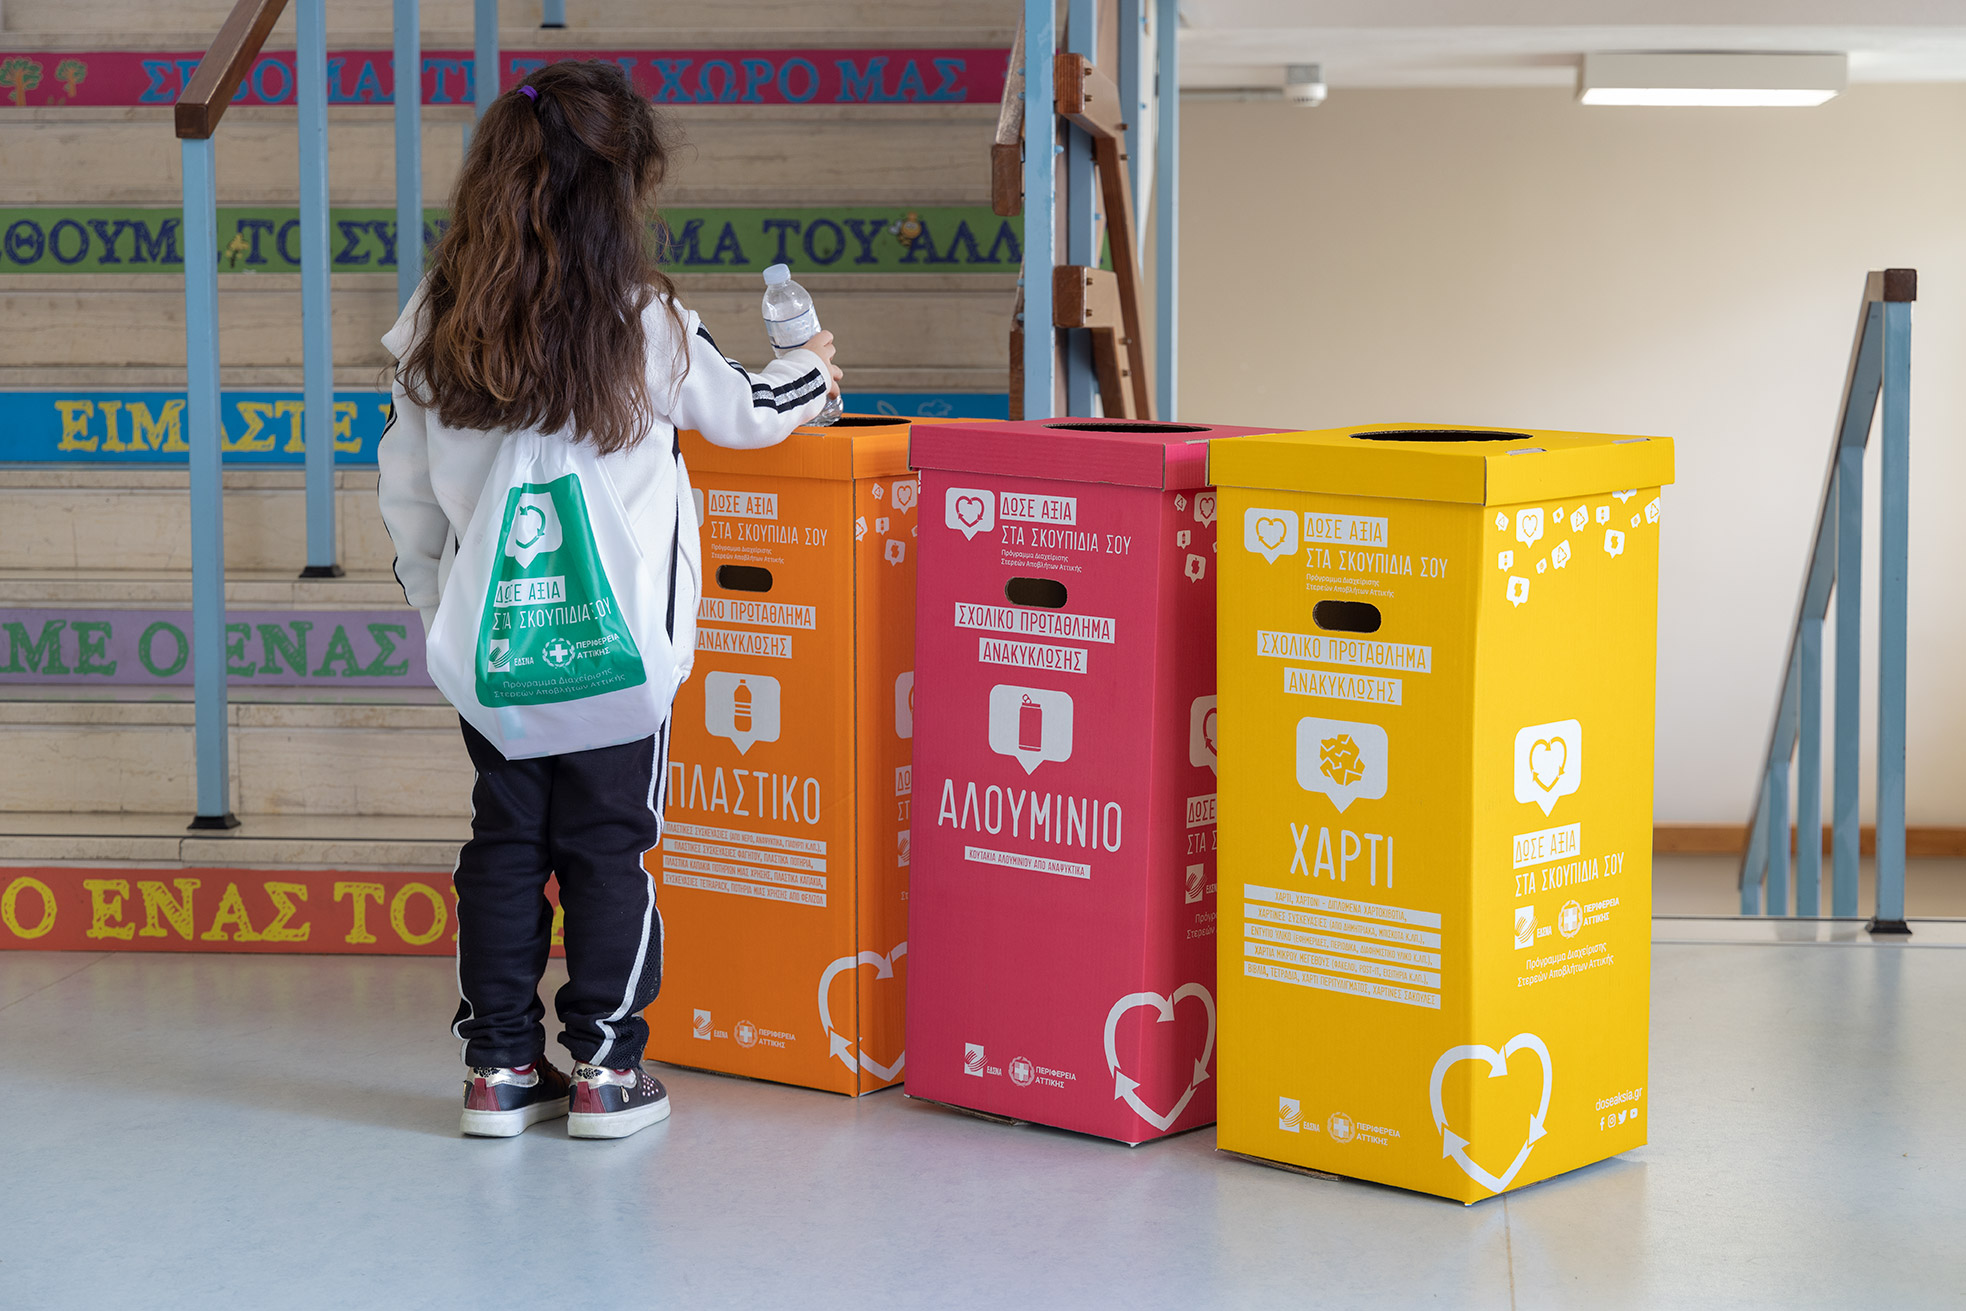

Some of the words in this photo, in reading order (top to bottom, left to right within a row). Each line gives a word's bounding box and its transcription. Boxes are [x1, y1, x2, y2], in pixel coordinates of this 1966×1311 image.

[652, 57, 820, 103] ΧΩΡΟ
[837, 57, 968, 102] ΜΑΣ
[0, 218, 220, 265] ΘΟΥΜ
[762, 218, 889, 266] ΤΟΥ
[898, 219, 1024, 264] ΑΛΛ
[54, 399, 362, 453] ΕΙΜΣΤΕ
[710, 494, 740, 513] ΔΩΣΕ
[746, 497, 774, 516] ΑΞΙΑ
[1002, 497, 1035, 518] ΔΩΣΕ
[1041, 500, 1072, 521] ΑΞΙΑ
[711, 521, 732, 540] ΣΤΑ
[738, 523, 799, 544] ΣΚΟΥΠΙΔΙΑ
[805, 527, 828, 546] ΣΟΥ
[1001, 525, 1025, 546] ΣΤΑ
[1031, 528, 1099, 552] ΣΚΟΥΠΙΔΙΑ
[1106, 534, 1131, 555] ΣΟΥ
[1306, 517, 1342, 540] ΔΩΣΕ
[1350, 520, 1382, 543] ΑΞΙΑ
[1000, 558, 1024, 568] Στερεών
[1059, 564, 1082, 574] Αττικής
[1001, 549, 1033, 559] Πρόγραμμα
[1306, 548, 1331, 569] ΣΤΑ
[1338, 550, 1413, 576] ΣΚΟΥΠΙΔΙΑ
[1420, 556, 1448, 578] ΣΟΥ
[529, 580, 560, 600] ΑΞΙΑ
[1306, 574, 1341, 584] Πρόγραμμα
[1342, 576, 1379, 587] Διαχείρισης
[1306, 583, 1331, 593] Στερεών
[1333, 585, 1368, 596] Αποβλήτων
[1369, 589, 1394, 599] Αττικής
[520, 604, 590, 629] ΣΚΟΥΠΙΔΙΑ
[697, 599, 725, 619] ΛΙΚΟ
[730, 602, 812, 627] ΠΡΩΤΑΘΛΗΜΑ
[958, 605, 1014, 630] ΣΧΟΛΙΚΟ
[1020, 612, 1110, 640] ΠΡΩΤΑΘΛΗΜΑ
[138, 621, 190, 677] Ο
[225, 620, 409, 678] ΕΝΑΣ
[575, 633, 620, 649] ΠΕΡΙΦΕΡΕΙΑ
[577, 647, 611, 659] ΑΤΤΙΚΗΣ
[698, 631, 787, 657] ΑΝΑΚΥΚΛΩΣΗΣ
[1261, 632, 1321, 659] ΣΧΟΛΙΚΟ
[1329, 639, 1426, 670] ΠΡΩΤΑΘΛΗΜΑ
[983, 641, 1081, 672] ΑΝΑΚΥΚΛΩΣΗΣ
[503, 678, 557, 689] Πρόγραμμα
[1289, 671, 1396, 703] ΑΝΑΚΥΚΛΩΣΗΣ
[668, 761, 820, 824] ΠΛΑΣΤΙΚΟ
[938, 778, 1122, 852] ΑΛΟΥΜΙΝΙΟ
[1188, 799, 1215, 823] ΔΩΣΕ
[1187, 832, 1206, 855] ΣΤΑ
[1289, 822, 1393, 888] ΧΑΡΤΙ
[1515, 836, 1544, 863] ΔΩΣΕ
[1550, 830, 1576, 856] ΑΞΙΑ
[1515, 871, 1536, 897] ΣΤΑ
[1541, 858, 1598, 892] ΣΚΟΥΠΙΔΙΑ
[1604, 852, 1625, 877] ΣΟΥ
[1, 876, 58, 939] Ο
[83, 877, 311, 942] ΕΝΑΣ
[333, 881, 458, 945] ΤΟ
[1583, 897, 1620, 913] ΠΕΡΙΦΕΡΕΙΑ
[1583, 911, 1610, 927] ΑΤΤΙΚΗΣ
[1526, 951, 1566, 970] Πρόγραμμα
[1567, 941, 1607, 961] Διαχείρισης
[1517, 968, 1547, 987] Στερεών
[1548, 961, 1588, 980] Αποβλήτων
[1588, 953, 1614, 969] Αττικής
[758, 1028, 796, 1041] ΠΕΡΙΦΕΡΕΙΑ
[758, 1038, 786, 1049] ΑΤΤΙΚΗΣ
[1035, 1066, 1077, 1080] ΠΕΡΙΦΕΡΕΙΑ
[1035, 1077, 1065, 1088] ΑΤΤΙΚΗΣ
[1595, 1087, 1642, 1111] doseaksia.gr
[1356, 1122, 1400, 1138] ΠΕΡΙΦΕΡΕΙΑ
[1356, 1133, 1388, 1146] ΑΤΤΙΚΗΣ
